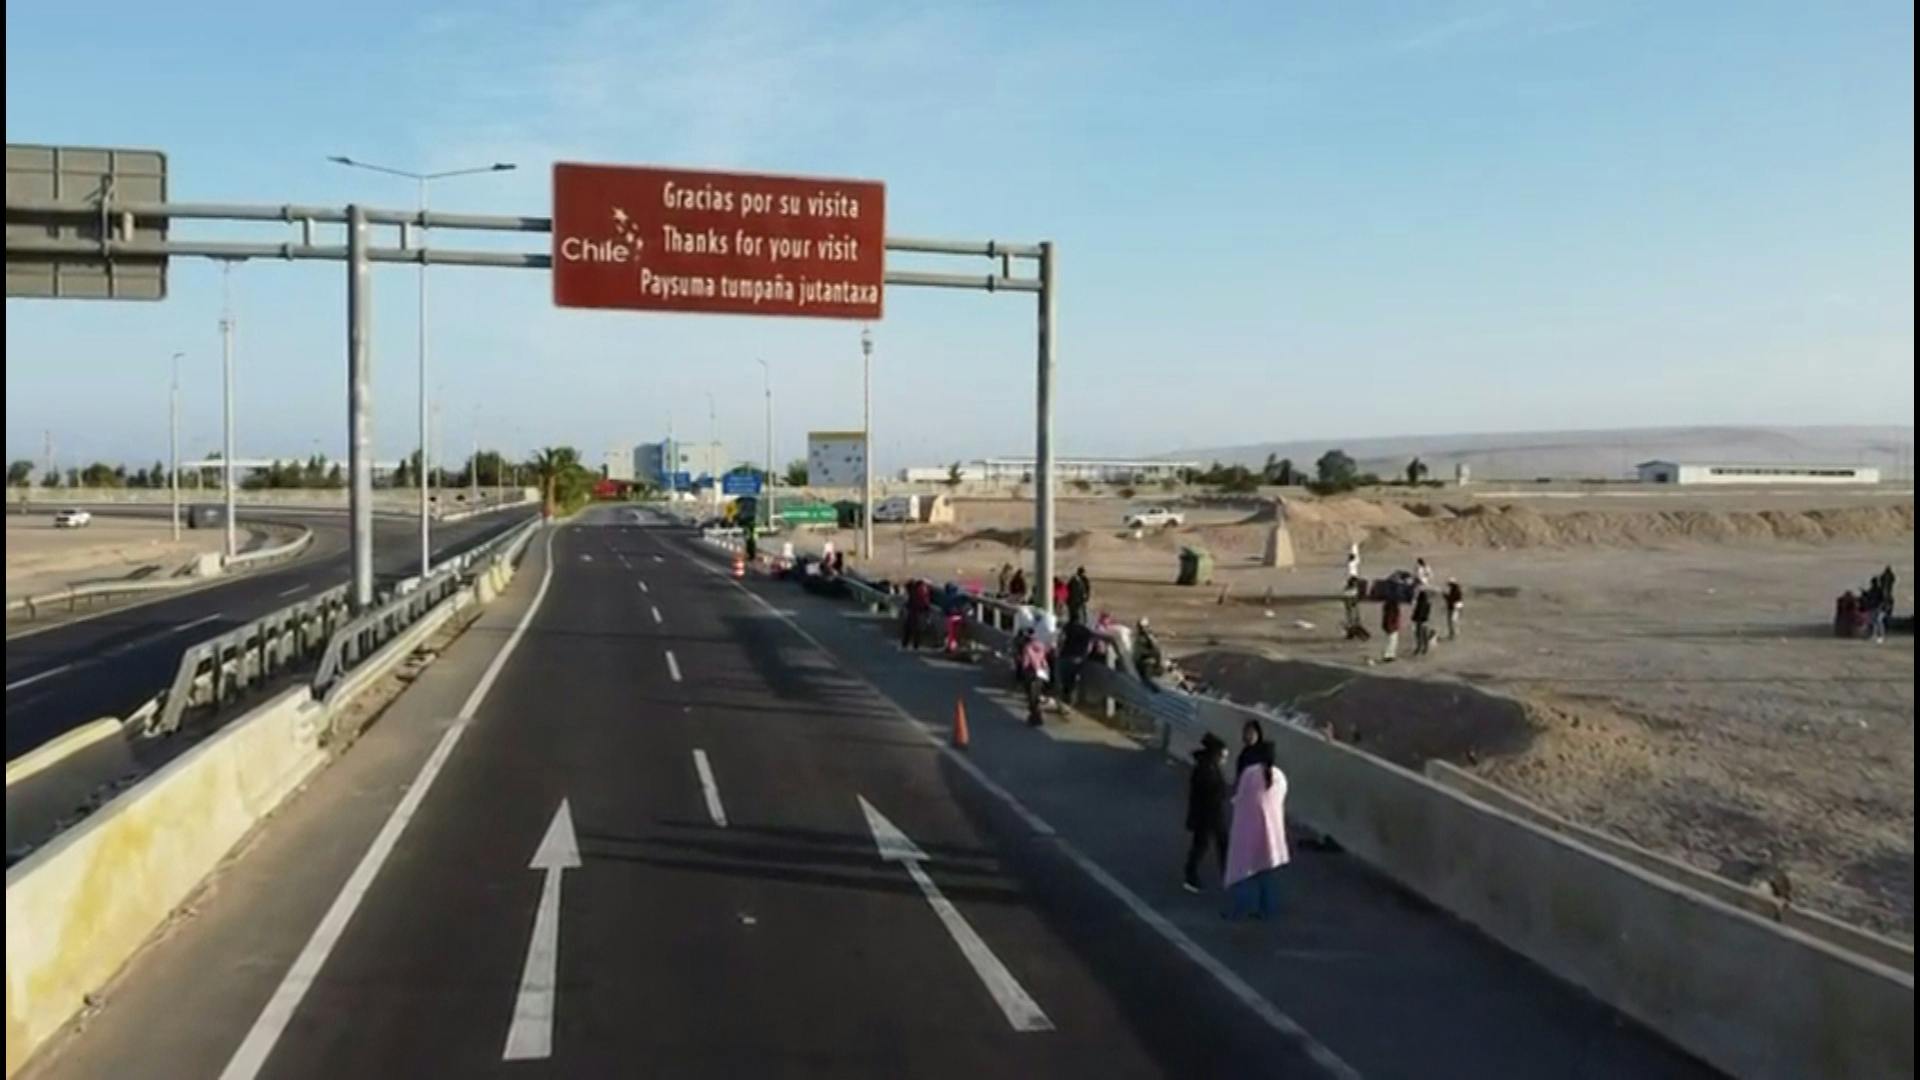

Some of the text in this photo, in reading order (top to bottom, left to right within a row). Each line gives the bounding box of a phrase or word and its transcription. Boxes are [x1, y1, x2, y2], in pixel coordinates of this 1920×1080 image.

[663, 181, 859, 218] Gracias por su visita
[561, 237, 629, 262] Chile
[663, 225, 858, 261] Thanks for your visit
[640, 268, 877, 306] Paysuma tumpaña jutantaxa
